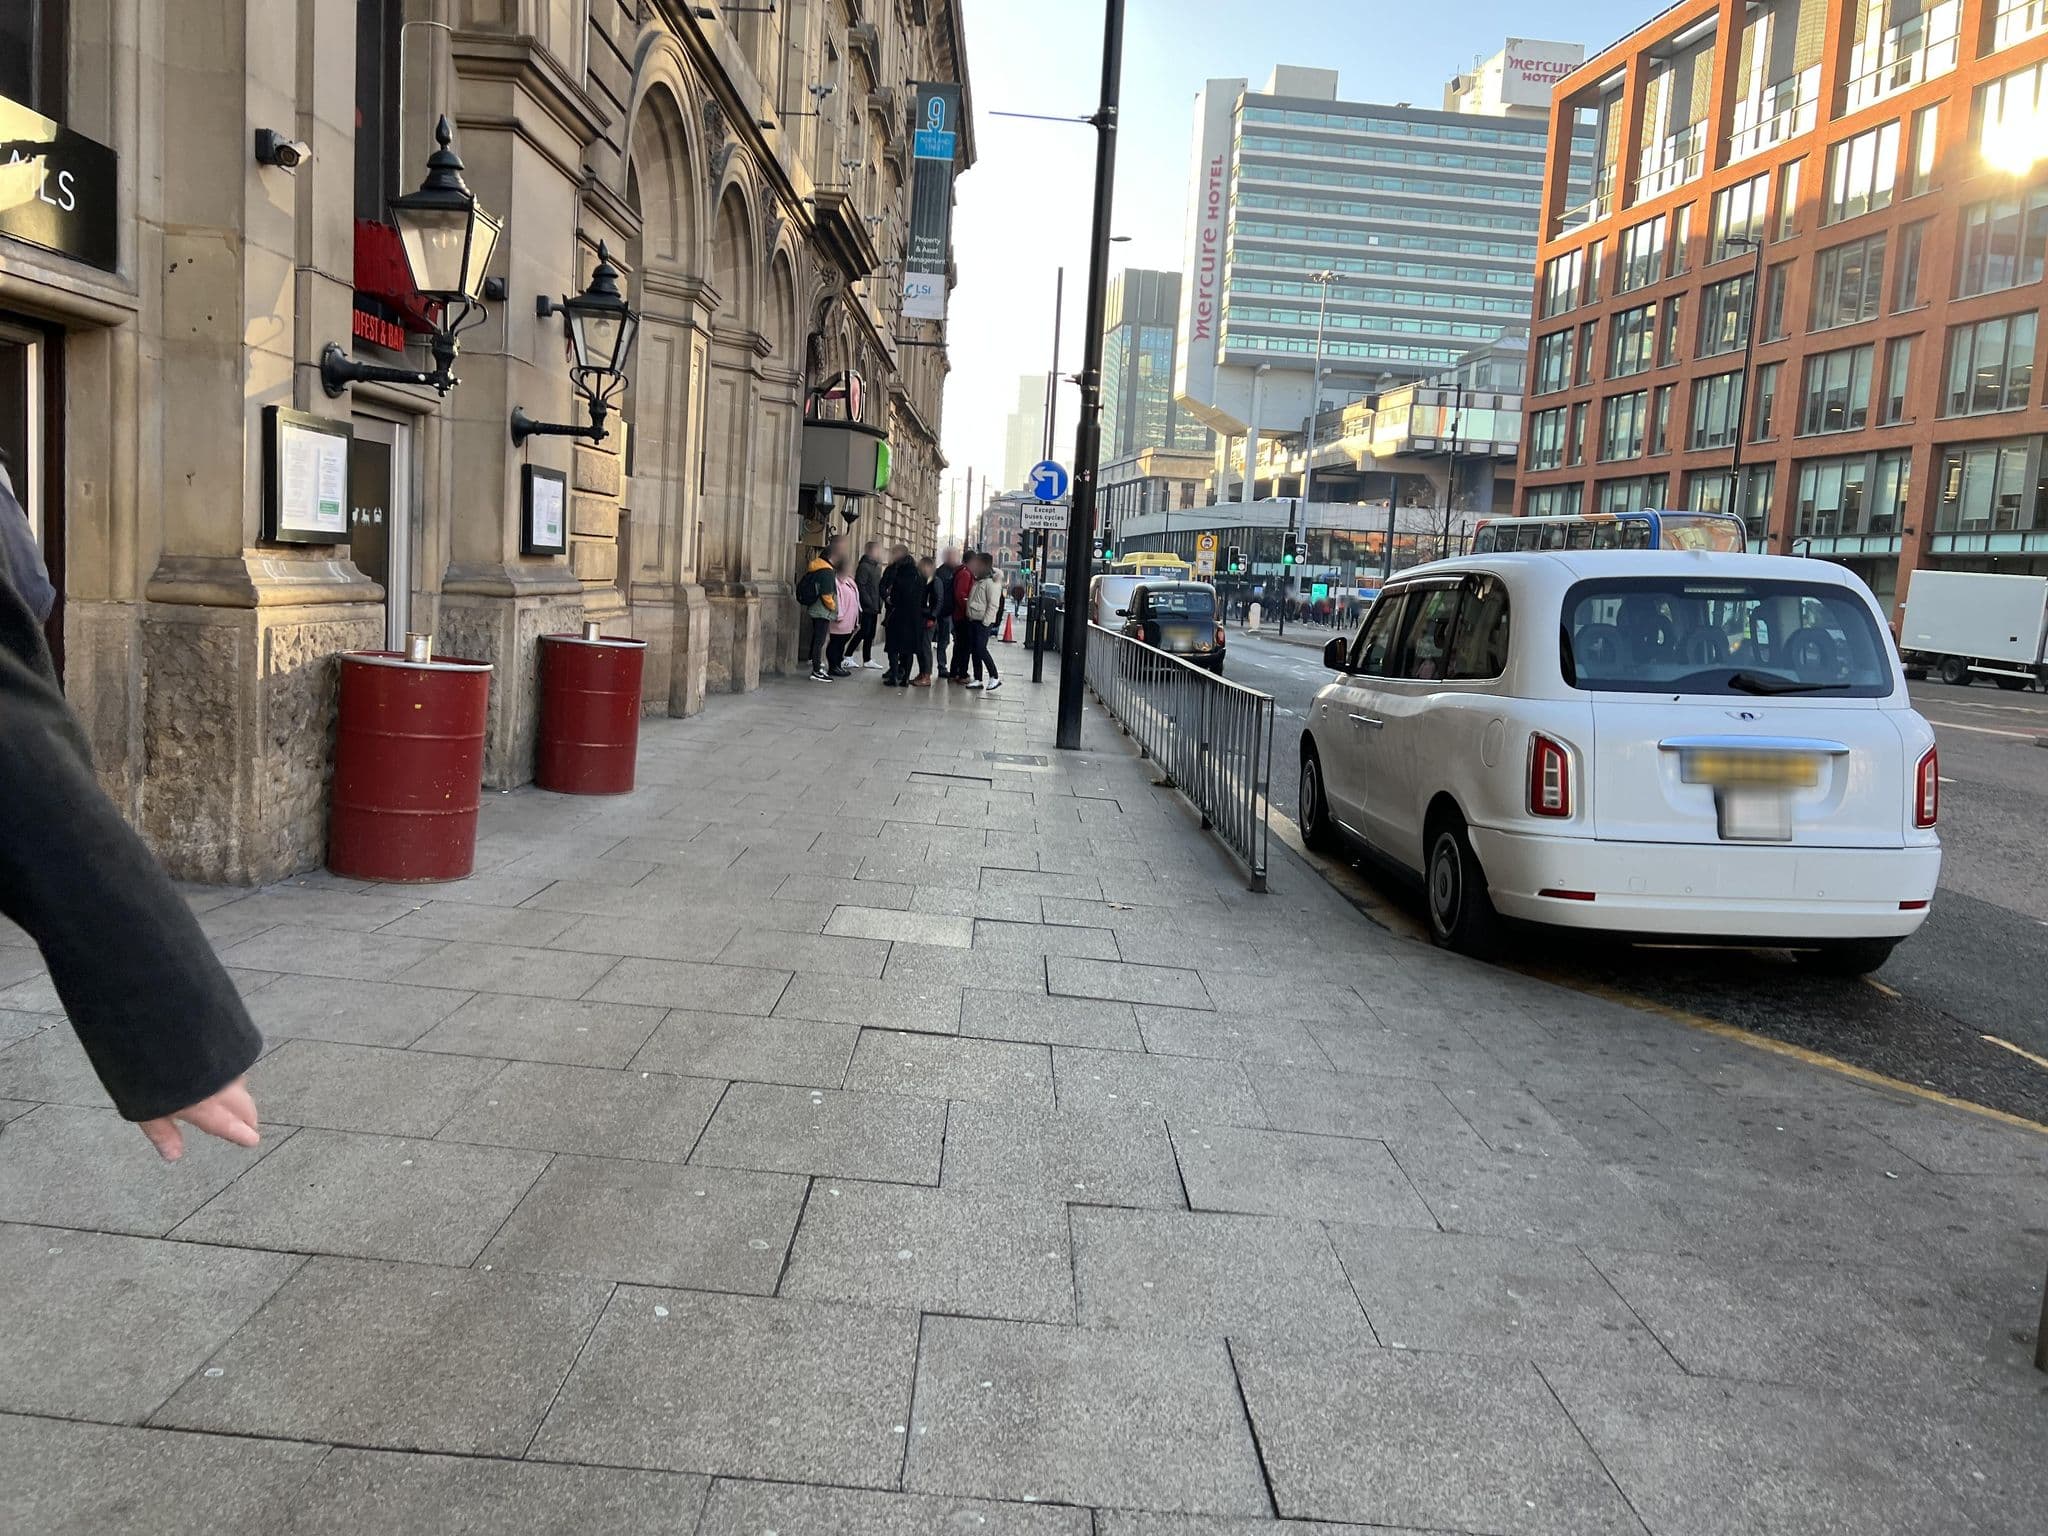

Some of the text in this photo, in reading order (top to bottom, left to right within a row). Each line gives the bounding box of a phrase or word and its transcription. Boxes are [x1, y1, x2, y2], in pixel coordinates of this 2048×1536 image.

[1522, 72, 1560, 84] HOTE
[927, 96, 946, 133] 9
[1208, 154, 1223, 220] HOTEL
[915, 235, 941, 246] Property
[915, 245, 921, 253] &
[906, 255, 946, 265] Management
[380, 320, 387, 346] &
[1034, 506, 1056, 514] Except
